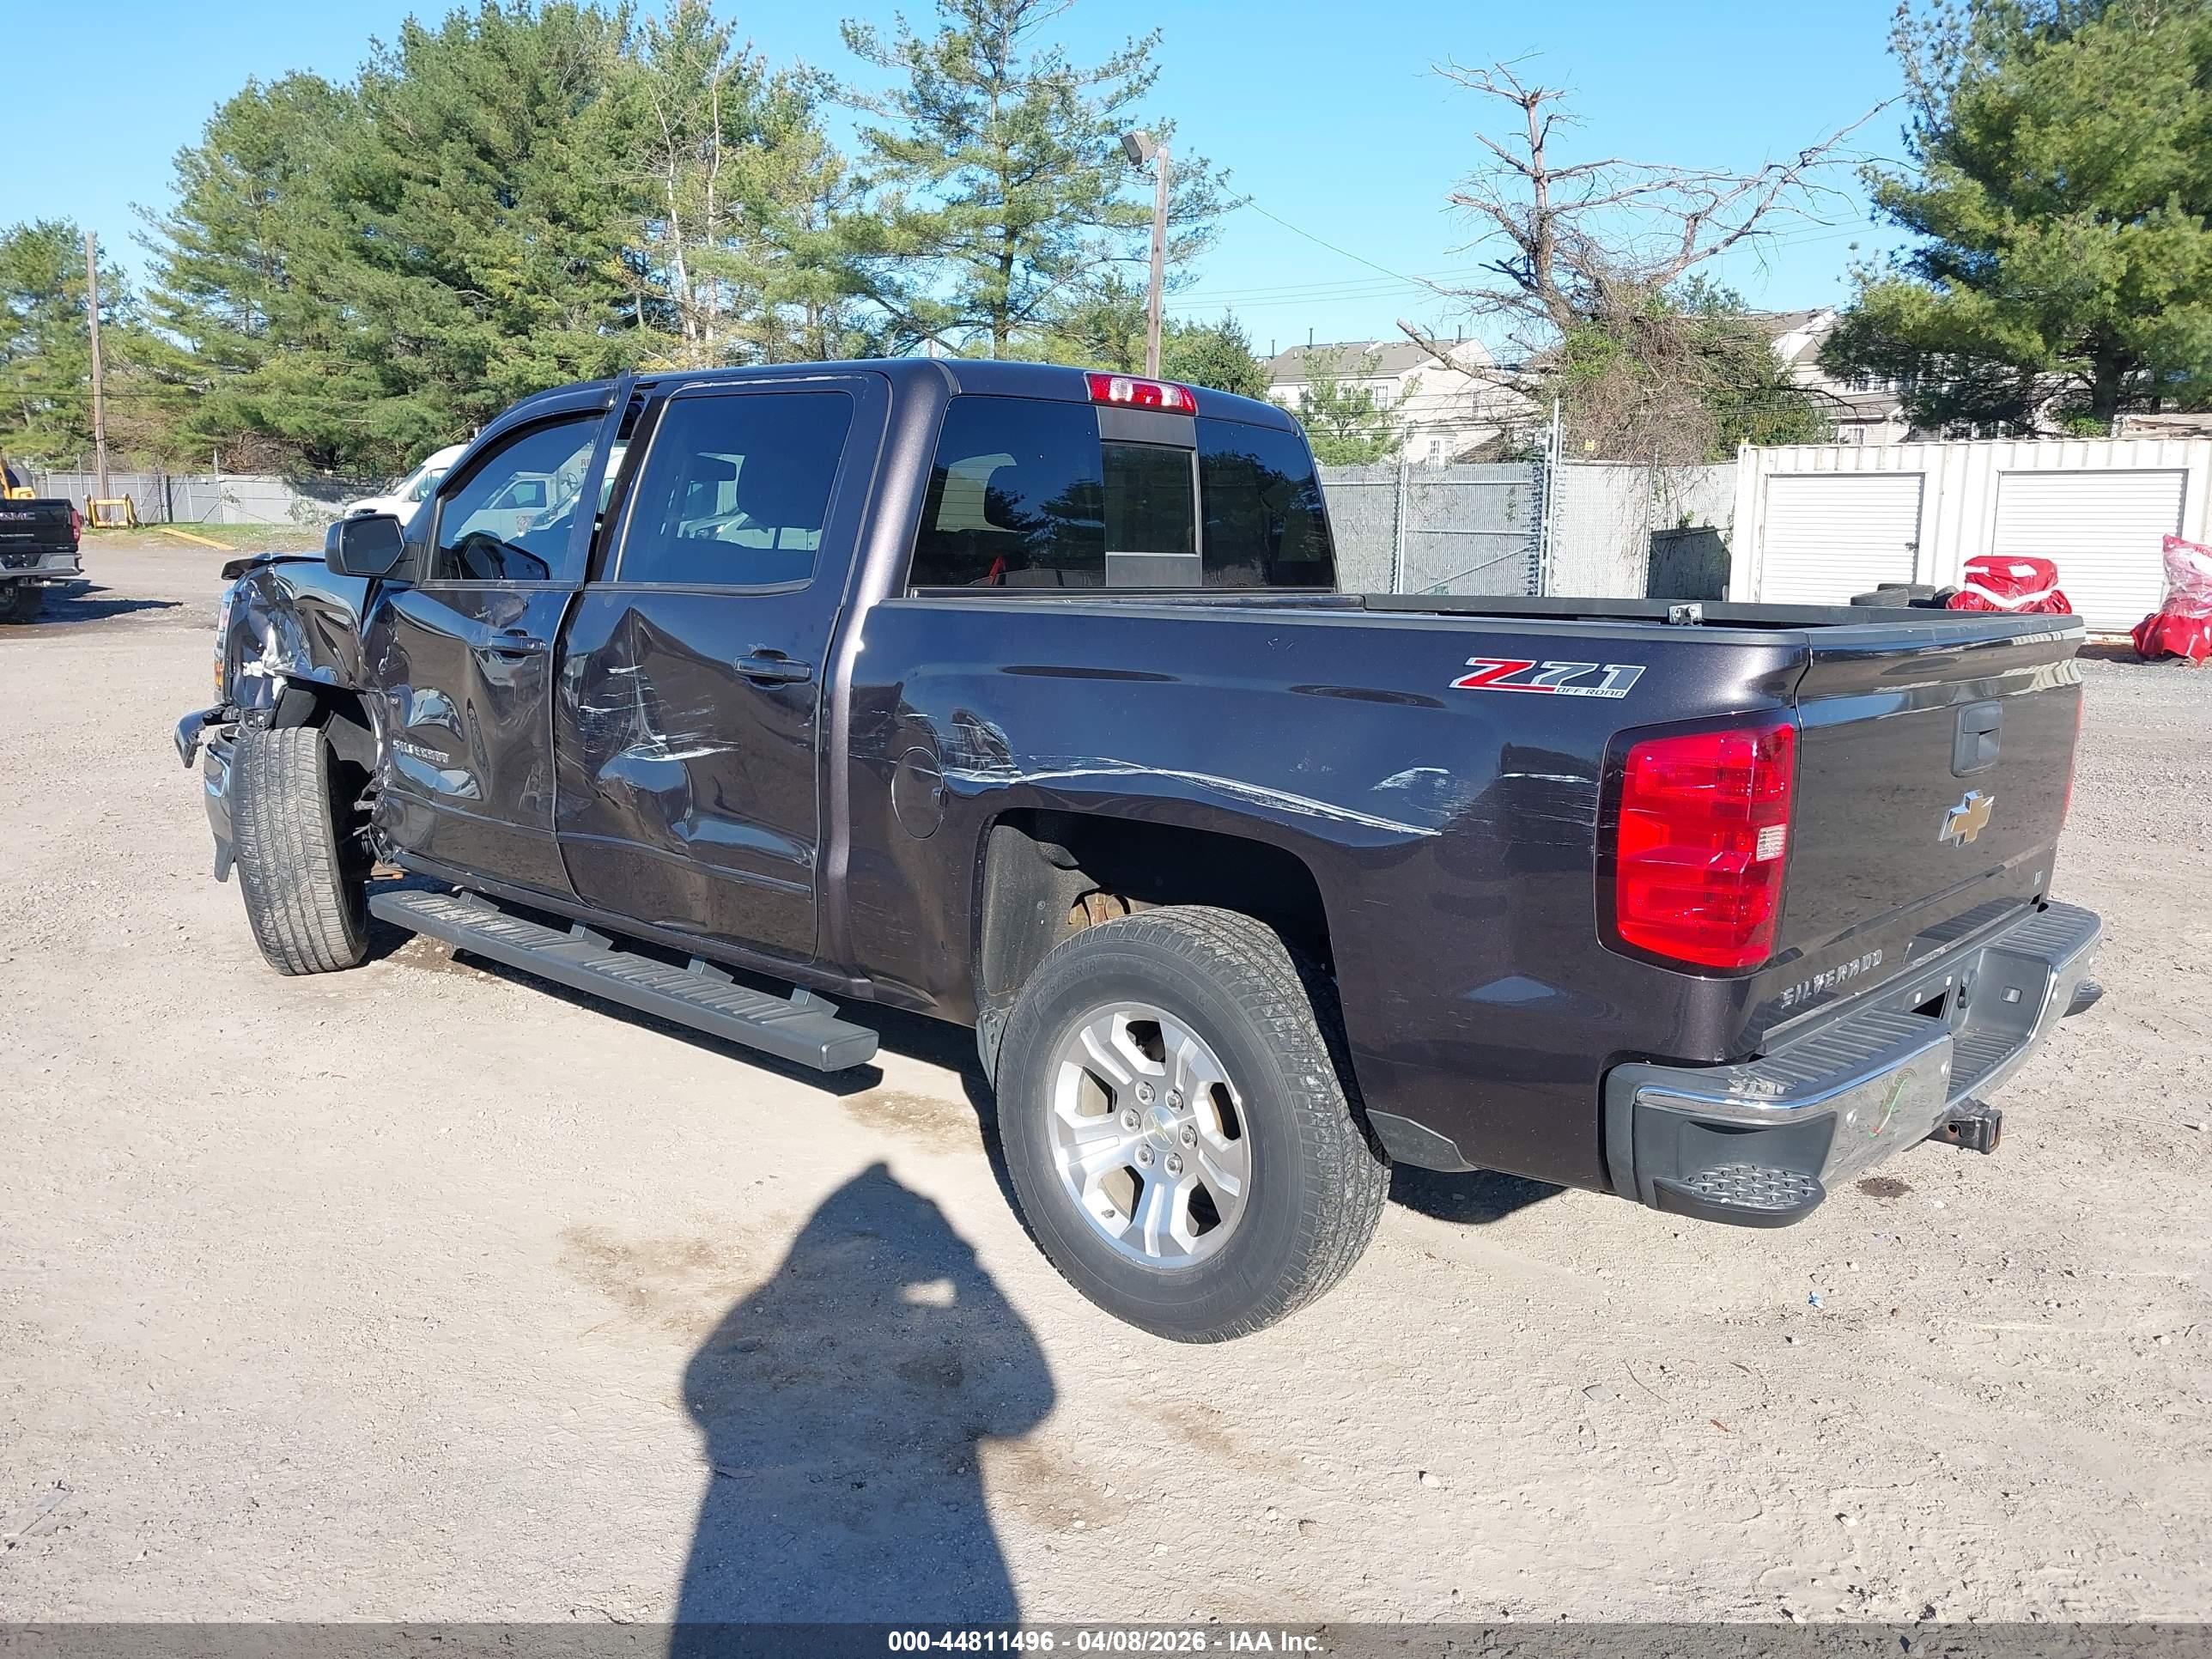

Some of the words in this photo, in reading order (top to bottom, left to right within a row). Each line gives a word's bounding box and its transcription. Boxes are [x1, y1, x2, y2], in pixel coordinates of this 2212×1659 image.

[1449, 657, 1647, 694] Z71
[1586, 689, 1626, 697] ROAD
[1780, 949, 1882, 1009] SILVERADO
